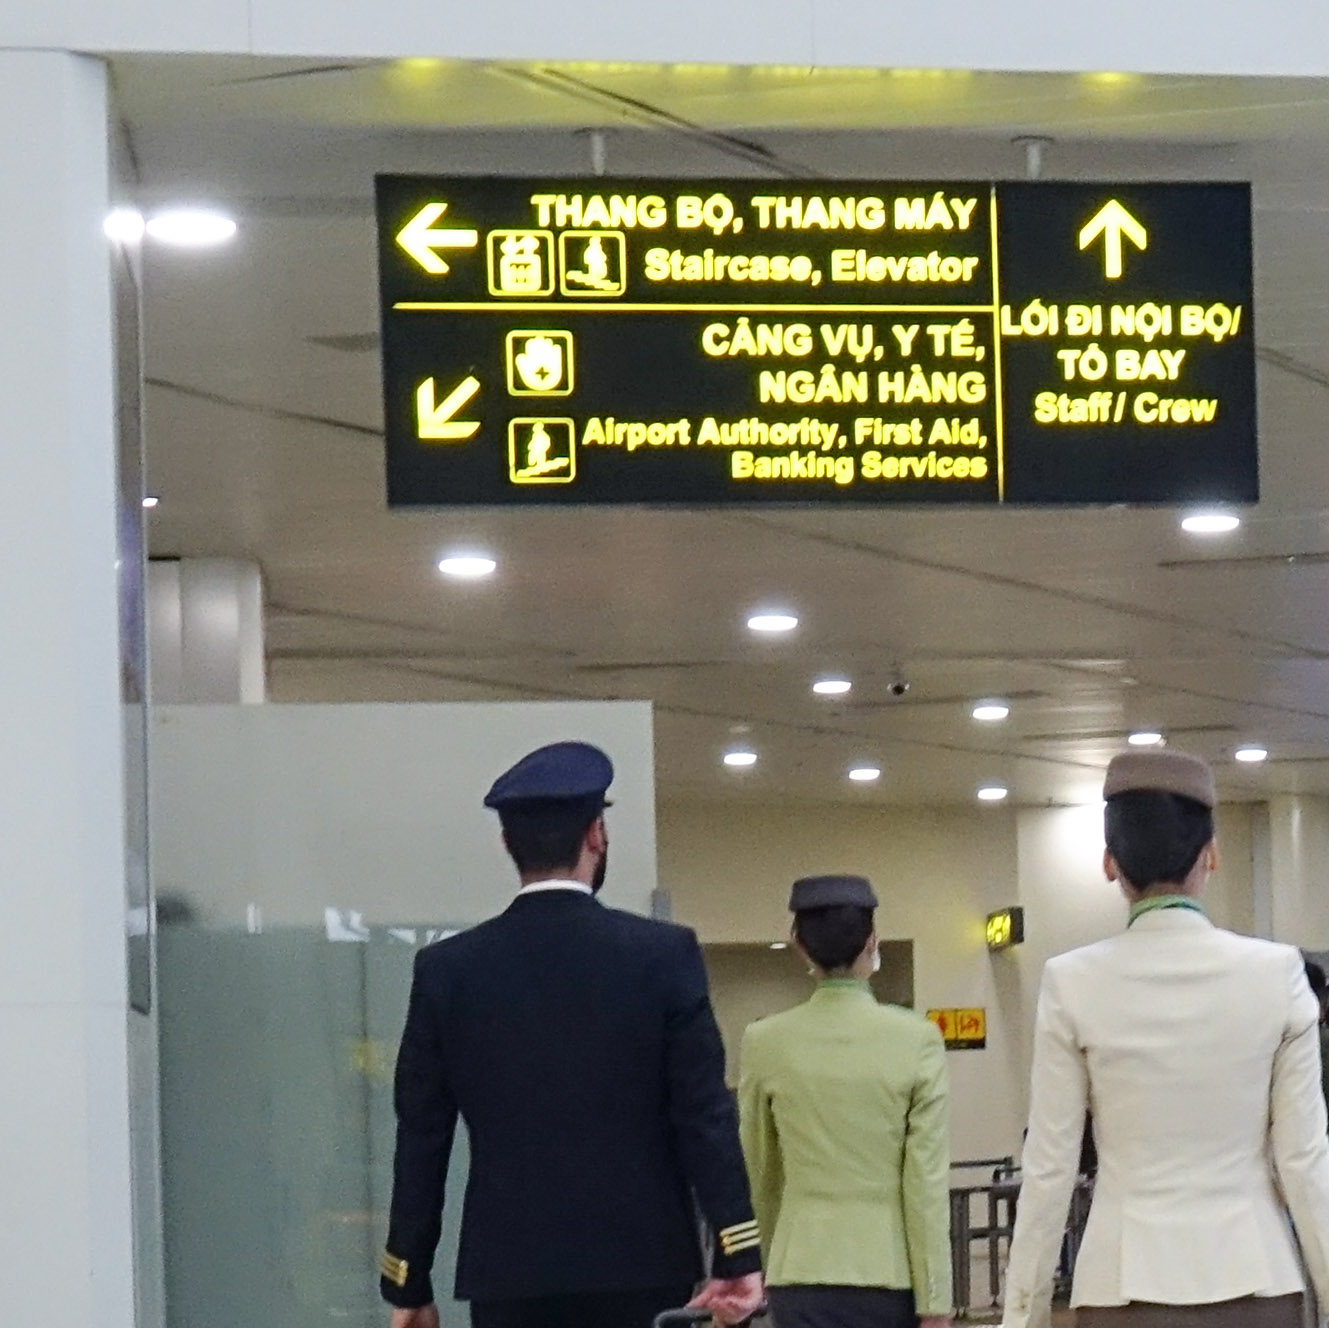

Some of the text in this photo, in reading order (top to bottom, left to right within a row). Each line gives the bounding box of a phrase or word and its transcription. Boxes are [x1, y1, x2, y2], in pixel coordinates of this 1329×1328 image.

[529, 192, 977, 235] THANG BỘ, THANG MÁY
[645, 248, 978, 286] Staircase, Elevator
[702, 317, 812, 356] CẢNG
[820, 324, 883, 363] VỤ,
[892, 325, 919, 356] Y
[1065, 305, 1102, 335] ĐI
[1111, 303, 1172, 342] NỘI
[760, 362, 986, 403] NGÂN HÀNG
[1116, 350, 1185, 380] BAY
[1134, 392, 1217, 423] Crew
[582, 417, 987, 452] Airport Authority, First Aid,
[732, 449, 987, 484] Banking Services
